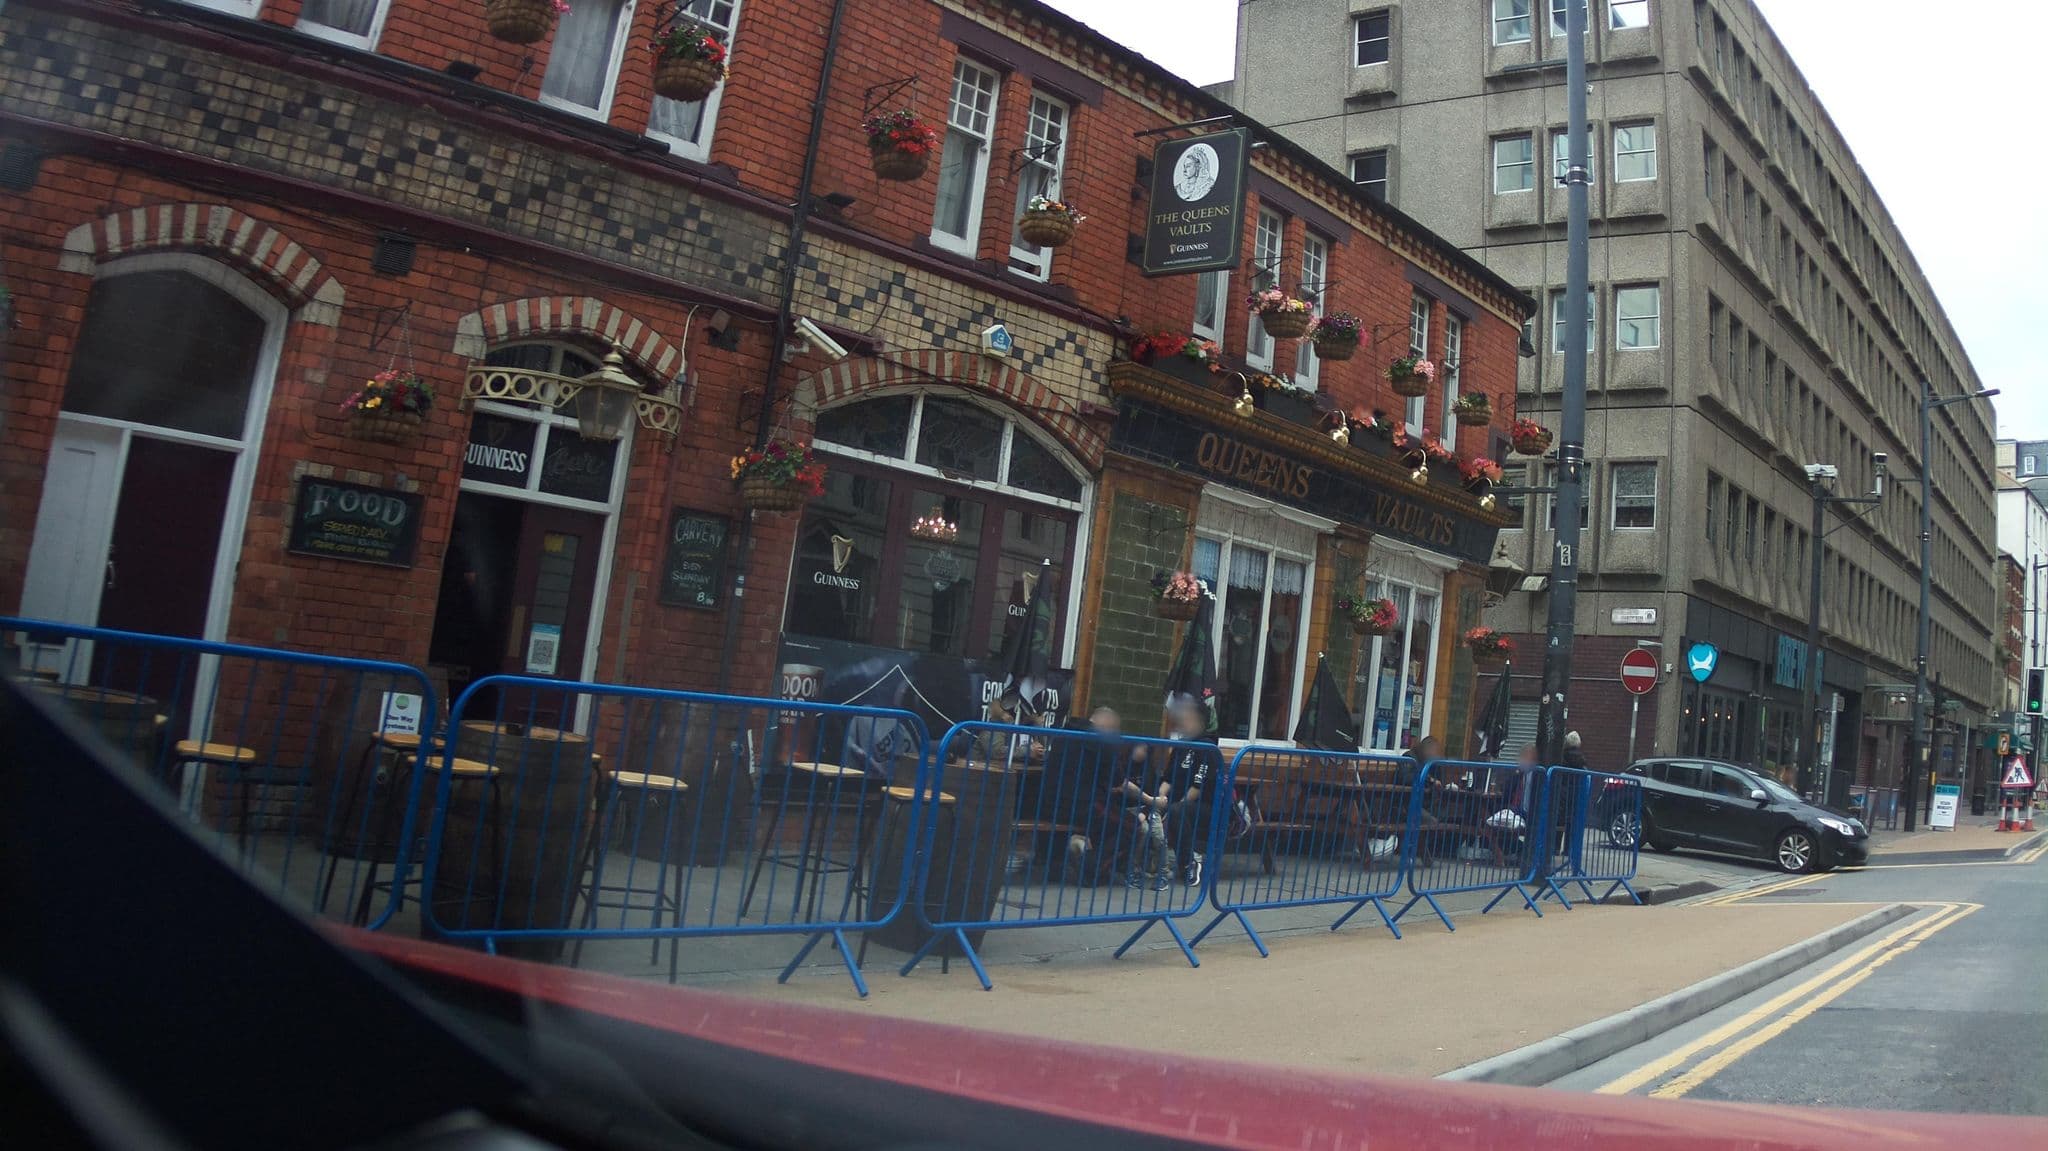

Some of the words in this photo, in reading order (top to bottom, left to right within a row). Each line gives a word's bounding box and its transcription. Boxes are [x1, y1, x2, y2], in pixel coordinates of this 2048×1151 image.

[1155, 211, 1178, 225] THE
[1181, 205, 1231, 222] QUEENS
[1169, 222, 1212, 238] VAULTS
[1176, 242, 1209, 252] GUINNESS
[464, 441, 528, 473] UINNESS
[1197, 431, 1312, 499] QUEENS
[1374, 494, 1457, 546] VAULTS
[304, 484, 407, 526] FOOD
[814, 571, 861, 590] GUINNESS
